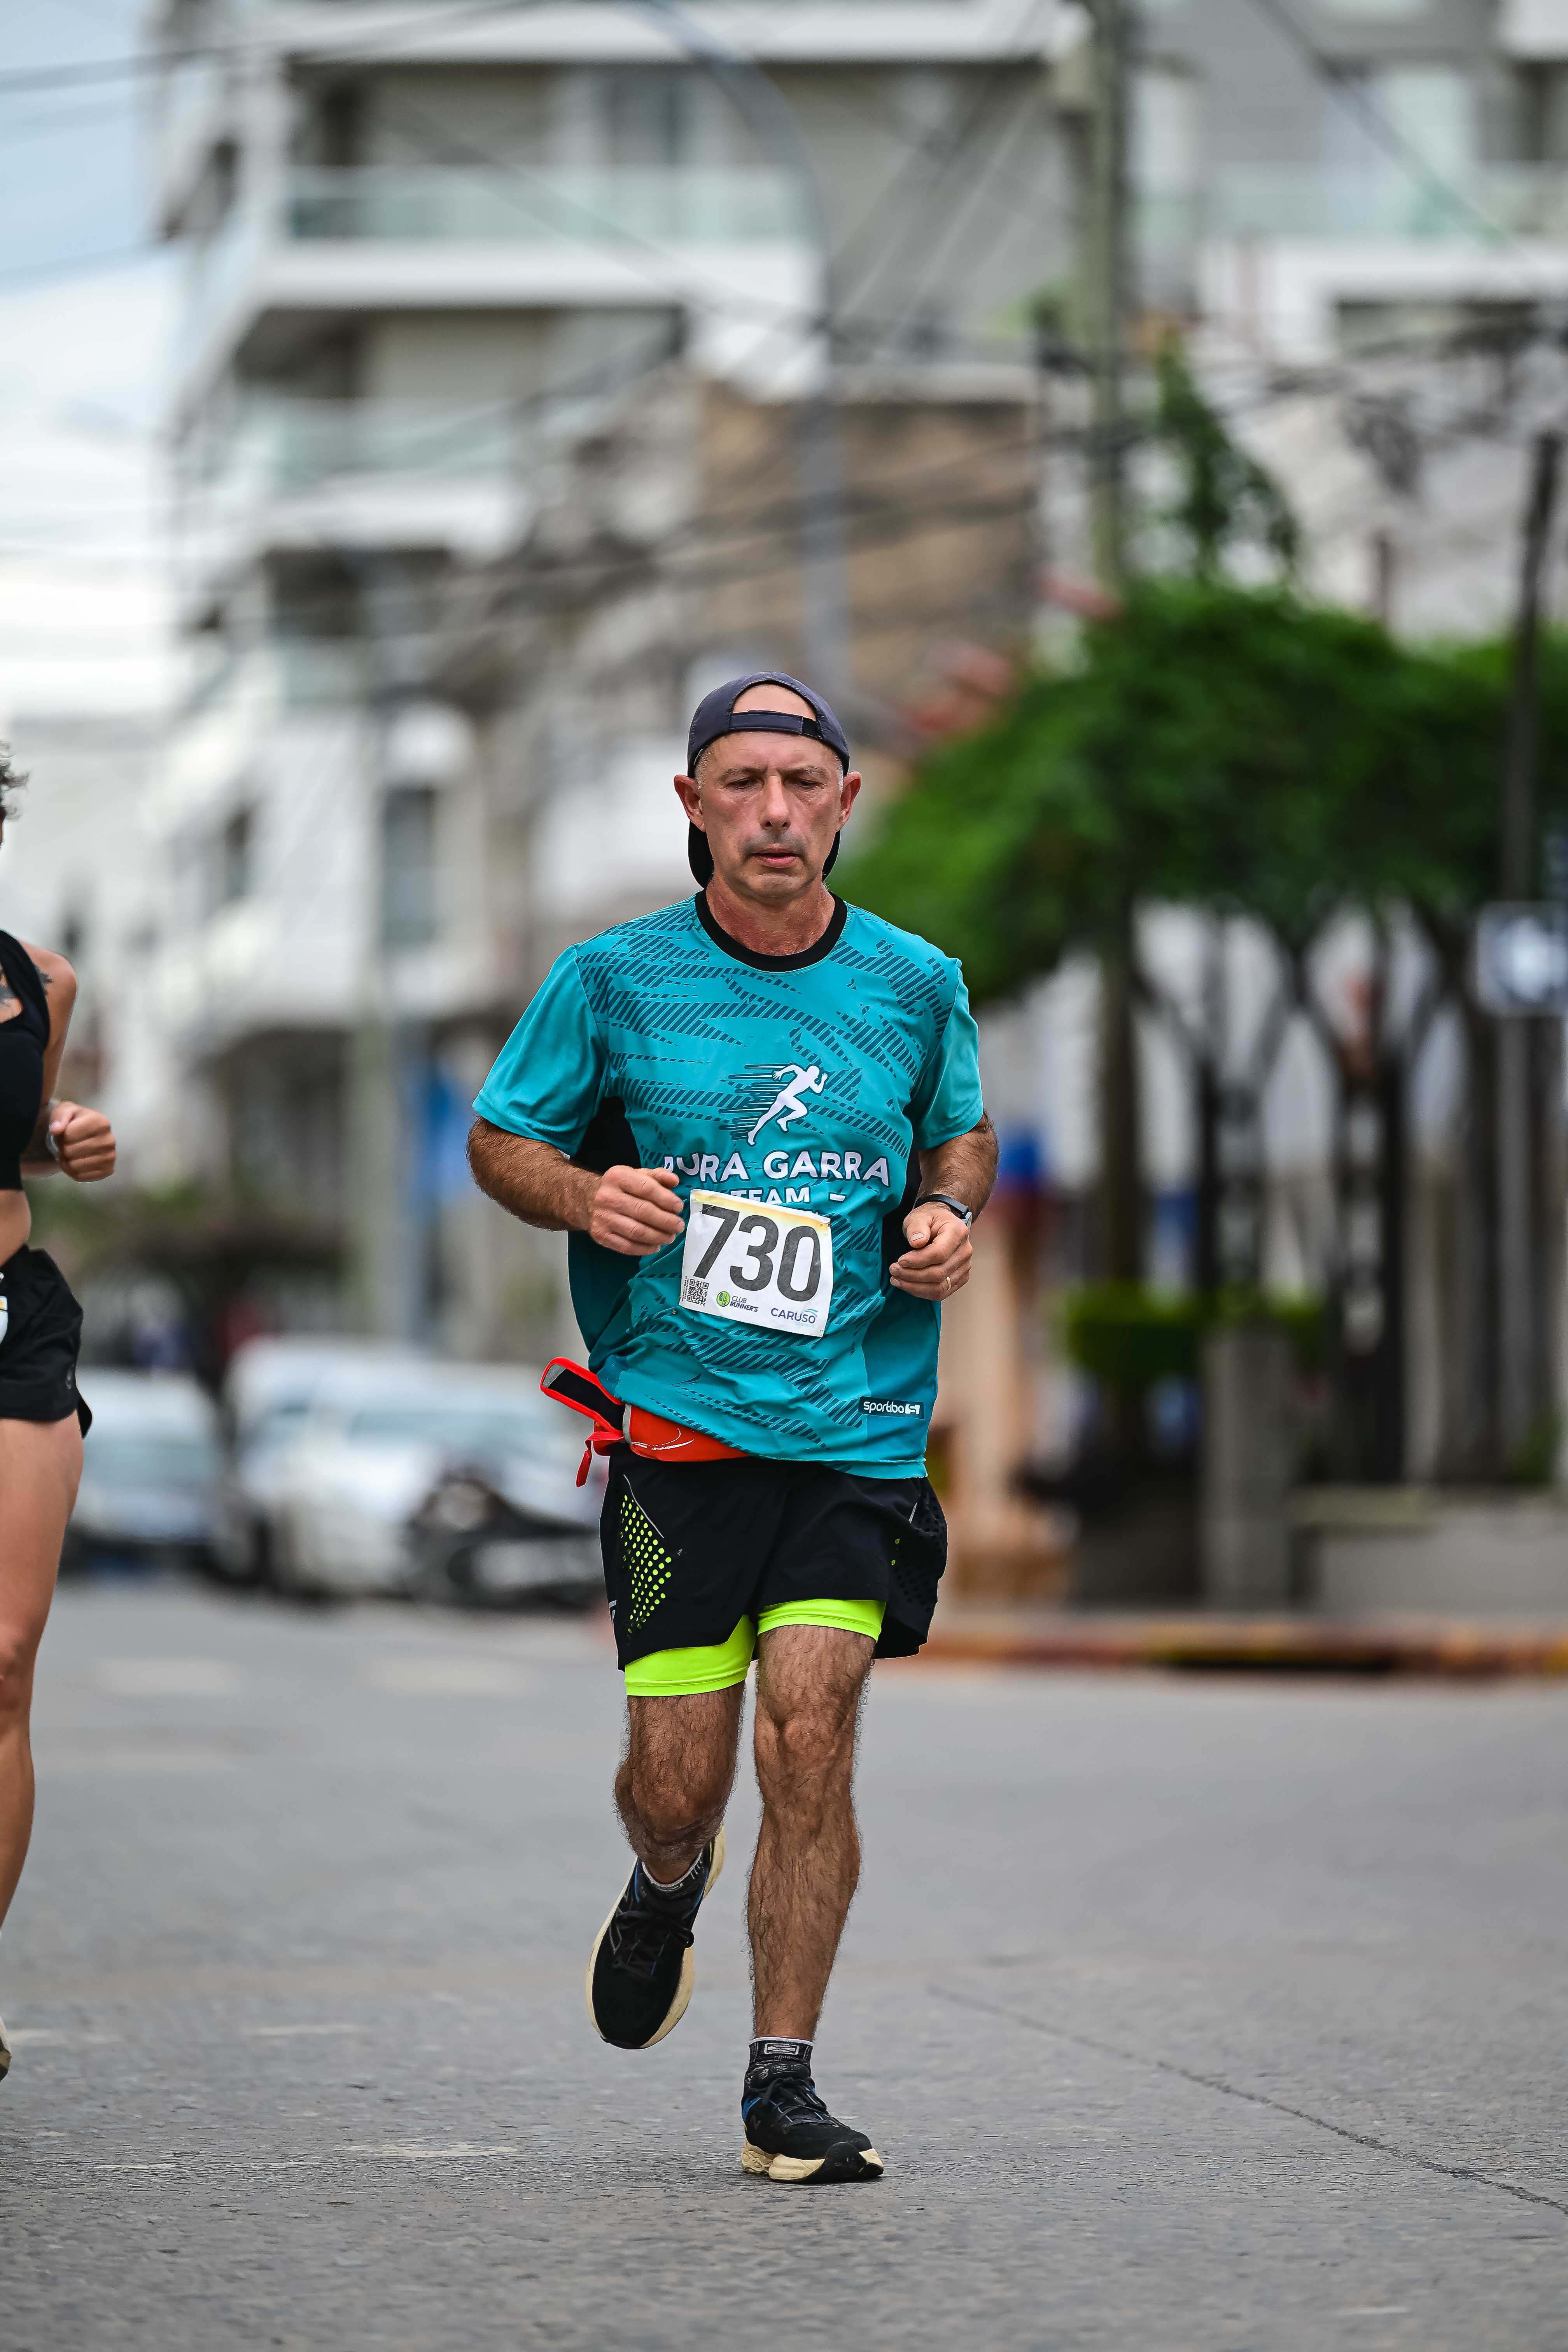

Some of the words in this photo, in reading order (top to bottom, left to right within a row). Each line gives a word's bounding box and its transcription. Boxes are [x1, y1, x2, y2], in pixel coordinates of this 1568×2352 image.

[763, 1151, 889, 1186] GARRA
[693, 1203, 821, 1302] 730
[771, 1308, 816, 1324] CARUSO
